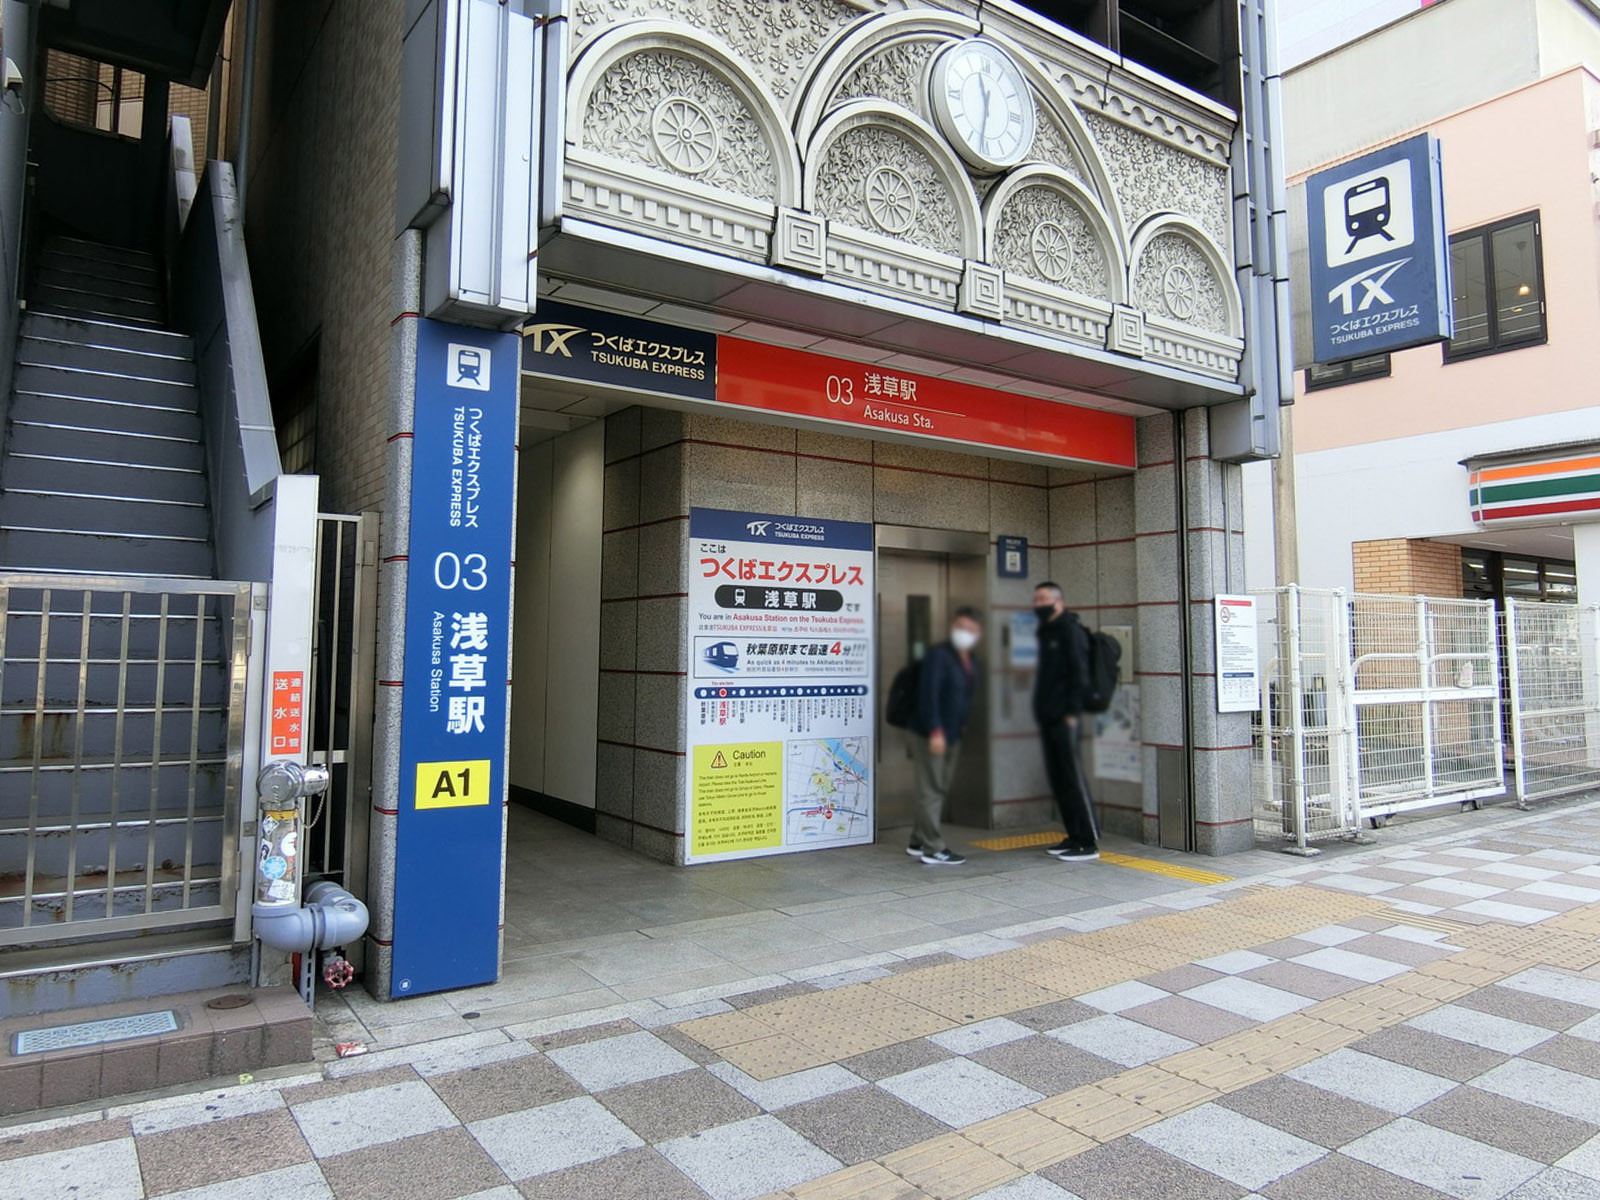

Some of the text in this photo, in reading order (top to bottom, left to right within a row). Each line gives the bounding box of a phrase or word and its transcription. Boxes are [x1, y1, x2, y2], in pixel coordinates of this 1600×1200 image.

[1328, 257, 1414, 315] TX
[1330, 304, 1419, 335] つくばエクスプレス
[1331, 317, 1420, 345] TSUKUBA EXPRESS
[523, 323, 588, 358] TX
[591, 332, 705, 366] つくばエクスプレス
[590, 350, 705, 381] TSUKUBA EXPRESS
[826, 375, 854, 405] 03
[864, 372, 917, 401] 浅草駅
[863, 405, 934, 429] Asakusa Sta.
[450, 406, 465, 527] TSUKUBA EXPRESS
[465, 407, 483, 528] つくばエクスプレス
[746, 520, 772, 536] TX
[700, 543, 726, 553] ここは
[434, 551, 488, 591] 03
[700, 557, 864, 586] つくばエクスプレス
[764, 589, 817, 609] 浅草駅
[845, 603, 860, 612] です
[733, 613, 763, 621] Asakusa
[764, 614, 788, 622] Station
[430, 610, 445, 713] Asakusa Station
[446, 612, 488, 734] 浅草駅
[274, 678, 288, 748] 送水口
[732, 749, 766, 760] Caution
[431, 768, 471, 799] A1
